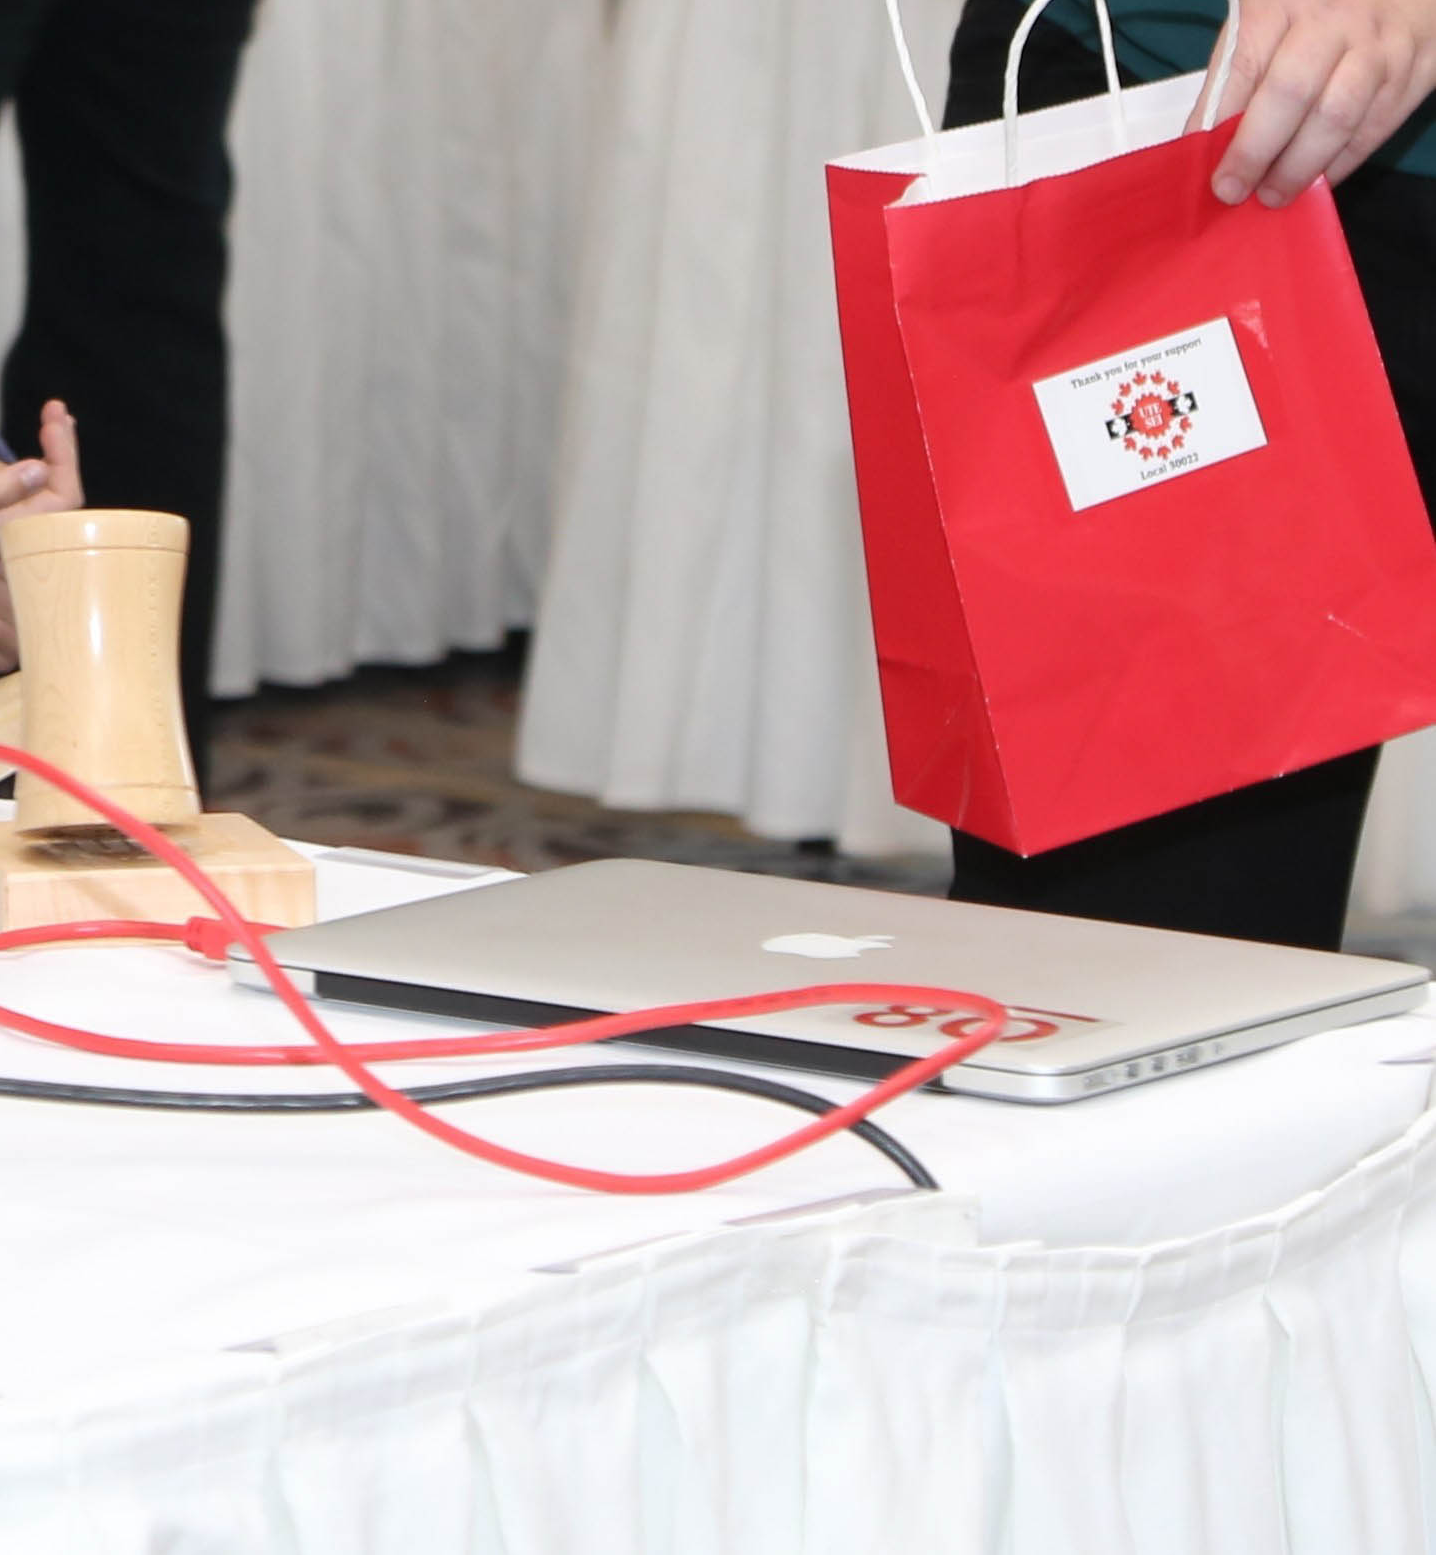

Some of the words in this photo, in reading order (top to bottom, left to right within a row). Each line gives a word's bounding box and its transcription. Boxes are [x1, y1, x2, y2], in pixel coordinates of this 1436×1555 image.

[1071, 371, 1102, 389] Thank
[1104, 365, 1123, 380] you
[1124, 359, 1138, 372] for
[1140, 351, 1162, 368] your
[1164, 337, 1202, 357] support
[1138, 402, 1162, 418] UTE
[1140, 463, 1167, 480] Local
